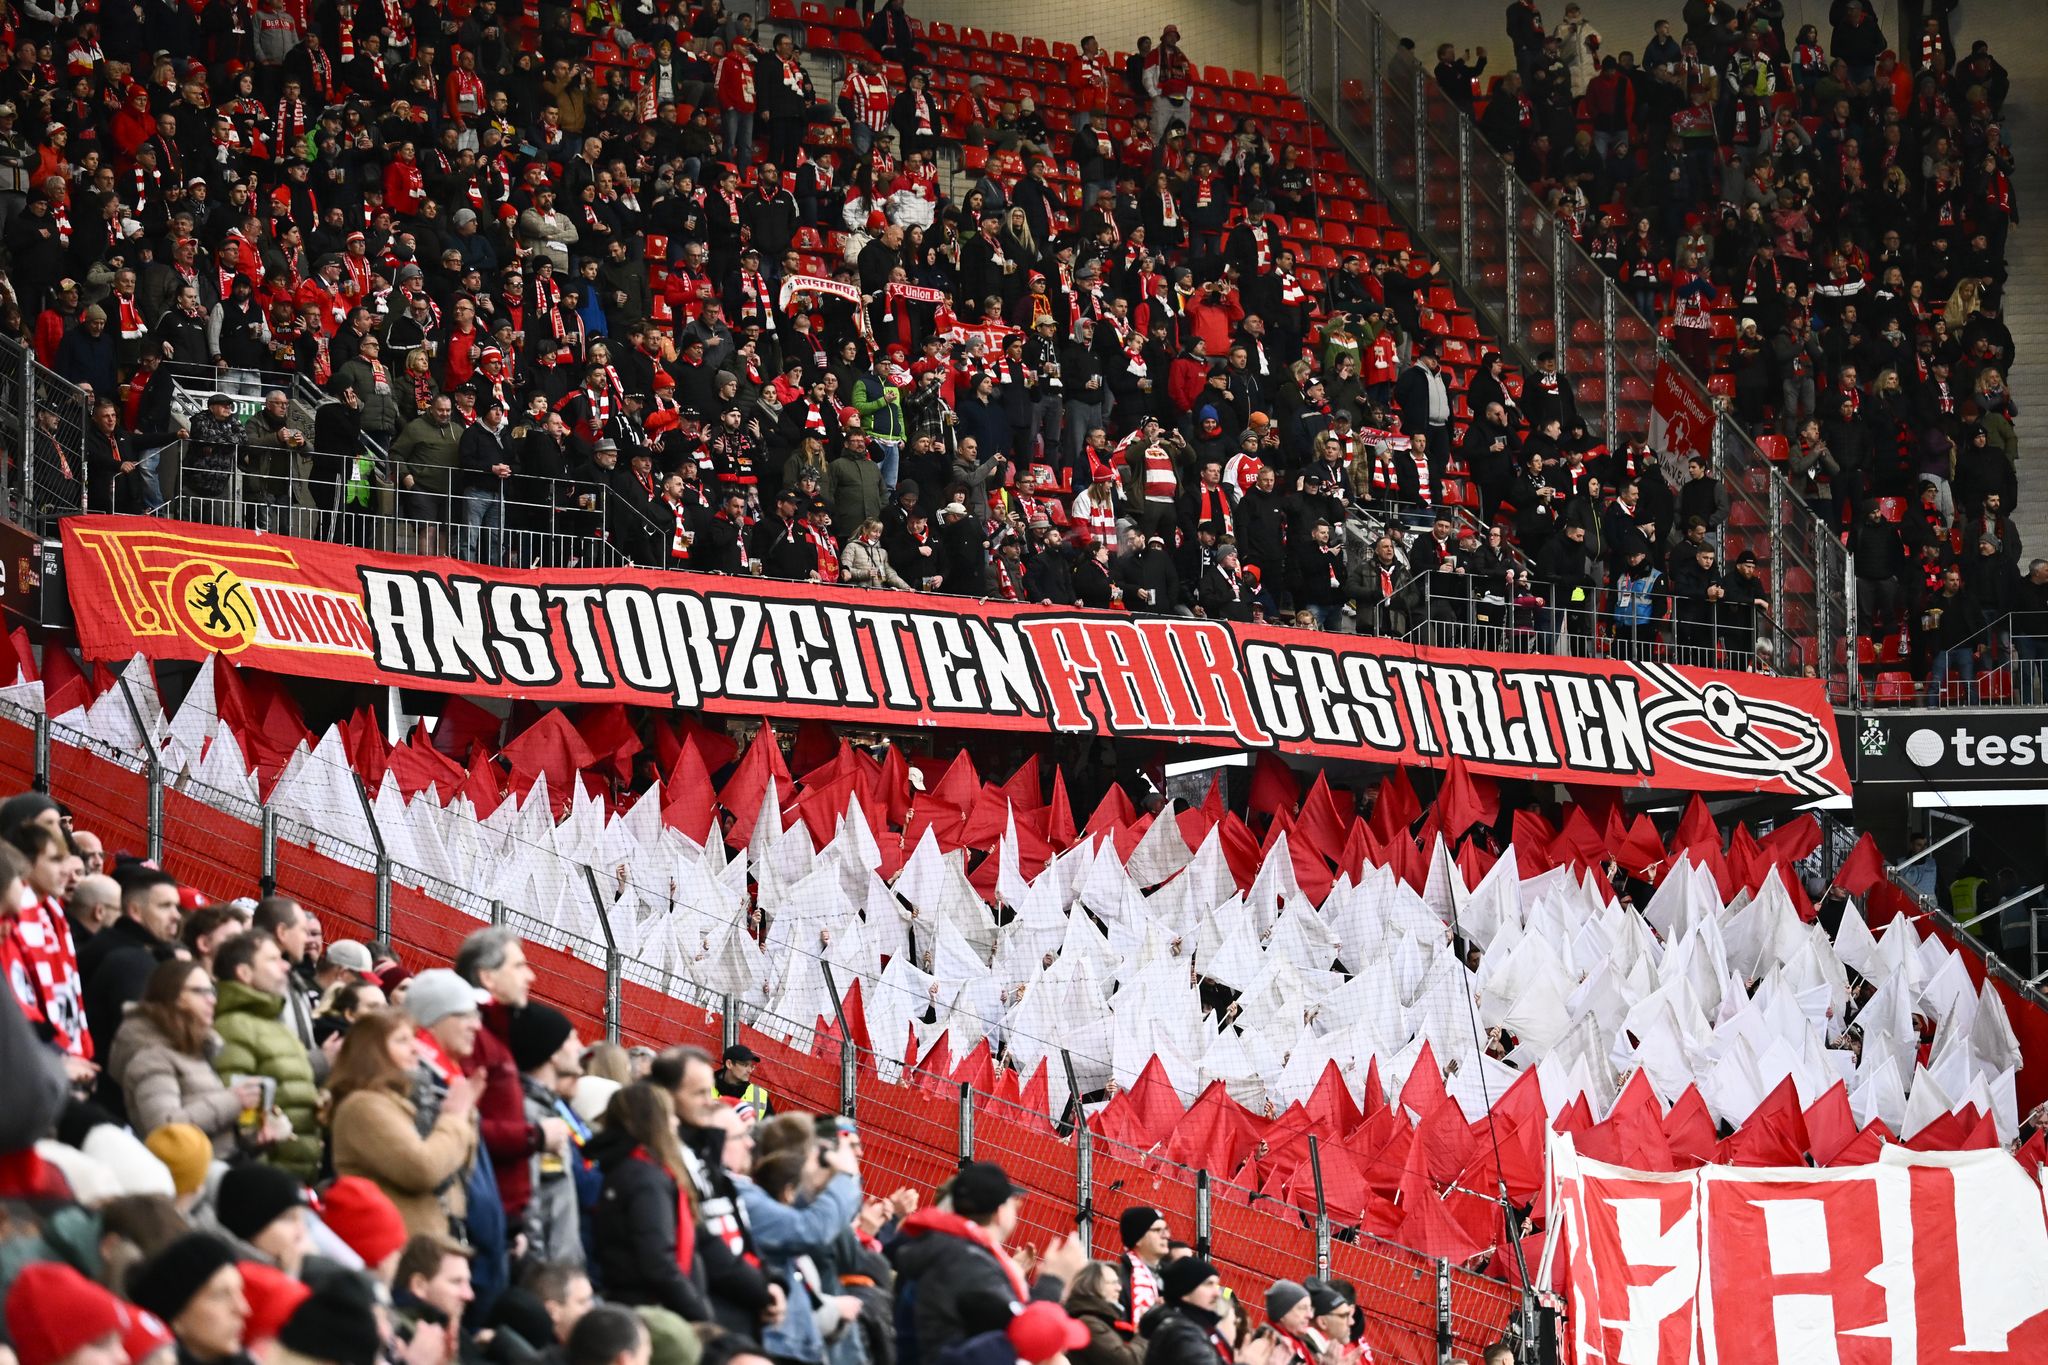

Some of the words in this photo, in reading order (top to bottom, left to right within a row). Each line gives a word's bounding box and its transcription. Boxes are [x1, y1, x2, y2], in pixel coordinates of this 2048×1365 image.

[905, 285, 931, 300] Union
[1665, 371, 1684, 400] Alpen
[1683, 391, 1709, 425] Unioner
[250, 586, 374, 651] UNION
[358, 566, 1045, 716] ANSTOßZEITEN
[1018, 617, 1274, 747] FAIR
[1244, 642, 1654, 774] GESTALTEN
